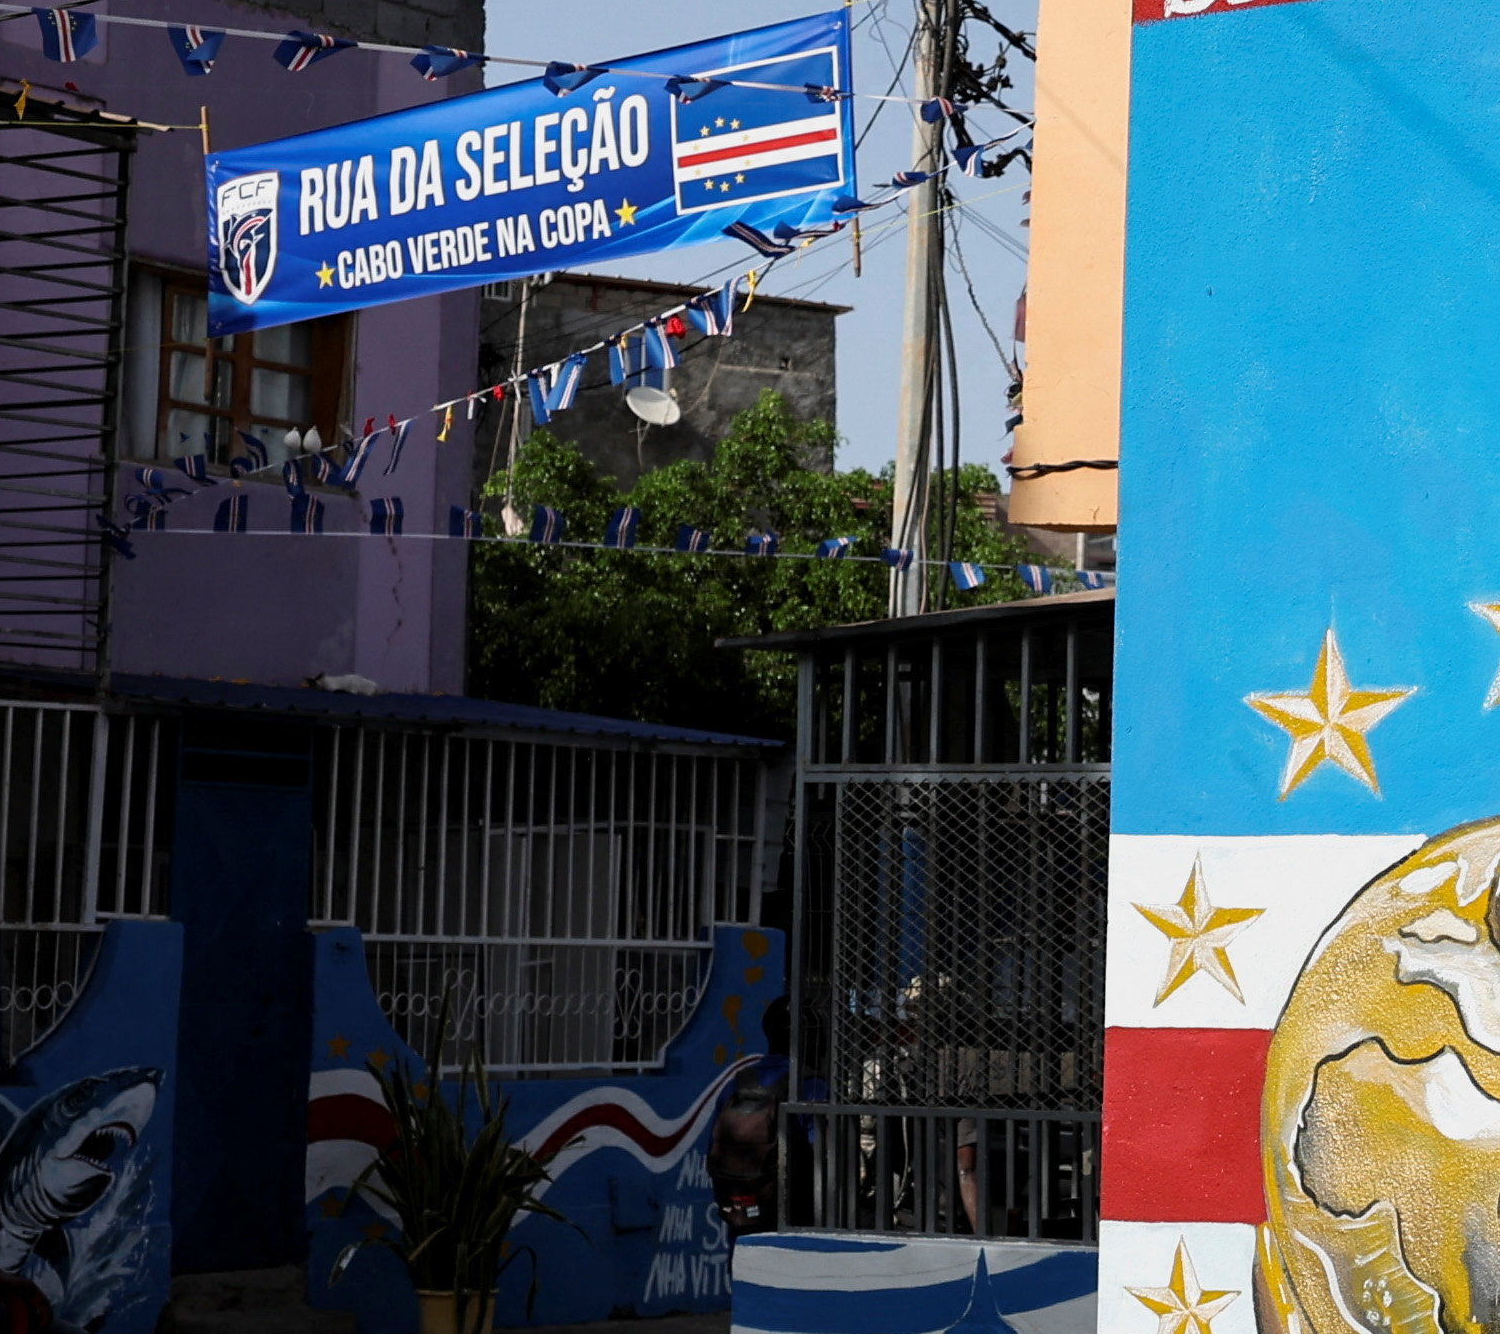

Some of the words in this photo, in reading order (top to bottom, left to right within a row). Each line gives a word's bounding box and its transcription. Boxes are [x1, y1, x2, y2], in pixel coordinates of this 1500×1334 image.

[221, 178, 274, 208] FCF
[300, 155, 379, 236] RUA
[389, 139, 446, 216] DA
[455, 86, 649, 202] SELEÇÃO
[337, 240, 404, 290] CABO
[406, 221, 492, 275] VERDE
[495, 213, 536, 258] NA
[540, 197, 613, 249] COPA
